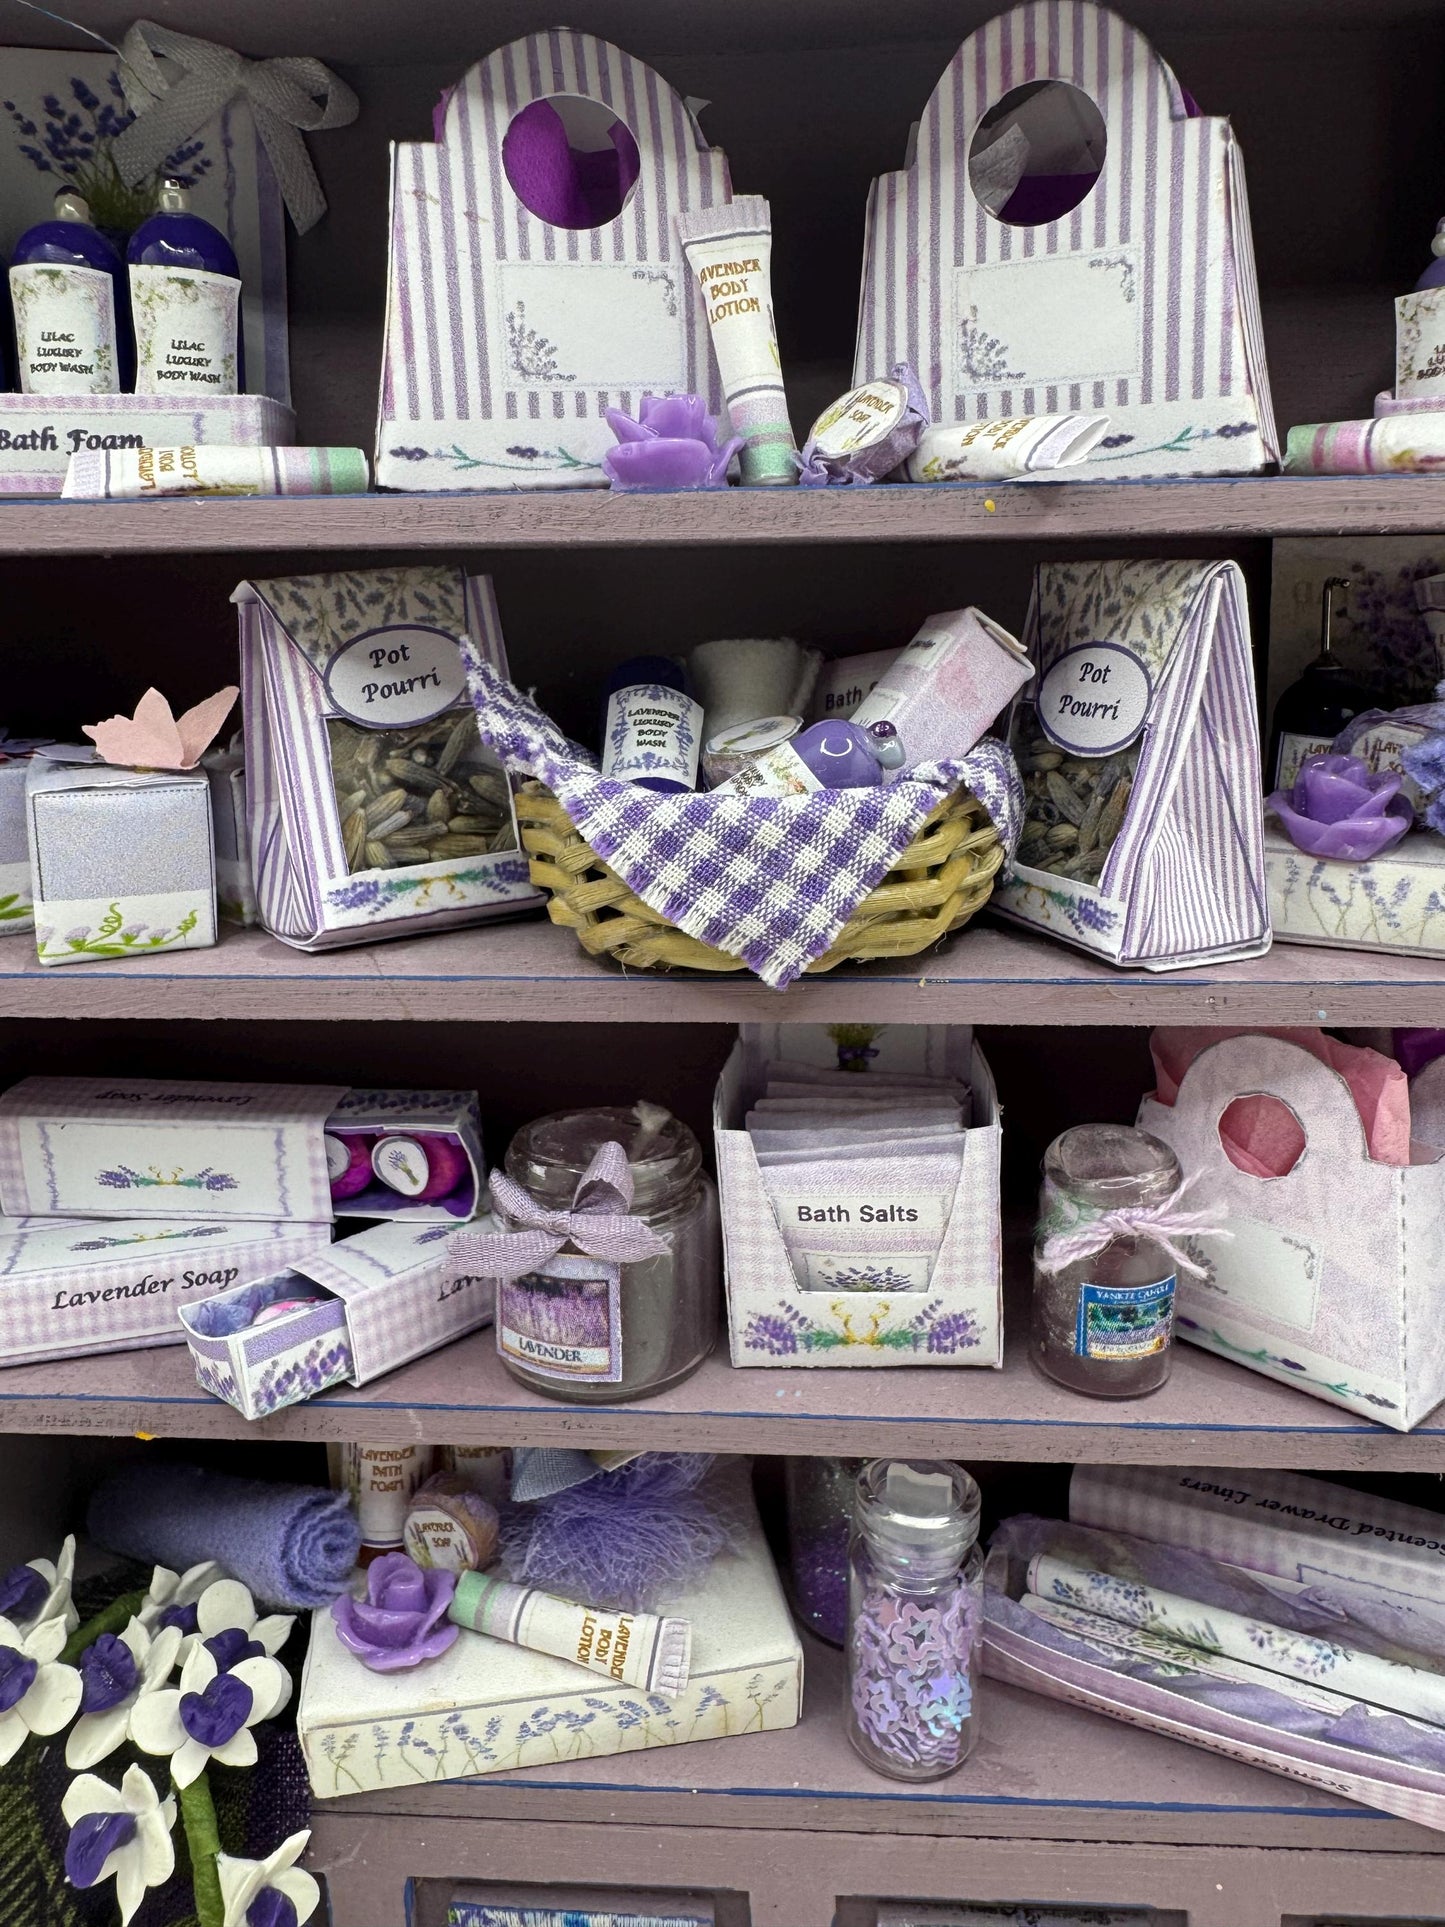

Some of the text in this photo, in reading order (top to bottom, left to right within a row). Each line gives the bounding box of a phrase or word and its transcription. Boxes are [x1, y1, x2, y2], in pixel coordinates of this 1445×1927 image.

[710, 278, 748, 301] BODY
[709, 297, 761, 324] LOTION
[41, 331, 76, 343] LILAC
[171, 338, 206, 352] LILAC
[36, 346, 83, 358] LUXURY
[165, 354, 212, 367] LUXURY
[30, 361, 94, 375] BODY WASH
[156, 369, 222, 384] BODY WASH
[0, 426, 146, 456] Bath Foam
[368, 644, 411, 669] Pot
[1078, 661, 1112, 685] Pot
[361, 666, 442, 704] Pourri
[825, 685, 863, 712] Bath
[1058, 694, 1121, 721] Pourri
[627, 707, 680, 721] LAVENDER
[632, 719, 675, 729] LUXURY
[636, 739, 667, 748] WASH
[637, 728, 668, 738] BODY
[797, 1204, 919, 1223] Bath Salts
[50, 1267, 240, 1310] Lavender Soap
[518, 1336, 583, 1363] LAVENDER
[360, 1445, 417, 1462] LAVENDER
[1178, 1476, 1253, 1505] Liners
[1255, 1497, 1351, 1532] Drawer
[576, 1616, 597, 1665] LOTION
[594, 1628, 613, 1665] BODY
